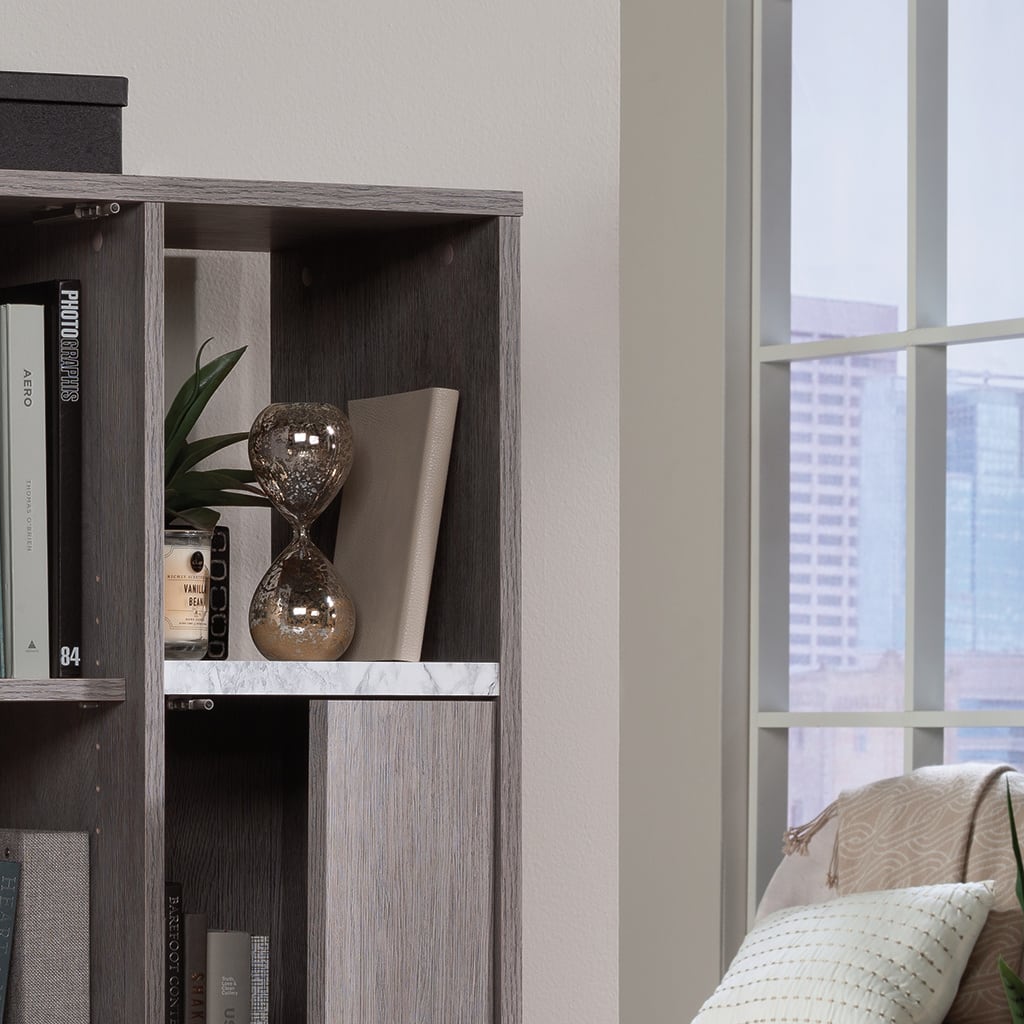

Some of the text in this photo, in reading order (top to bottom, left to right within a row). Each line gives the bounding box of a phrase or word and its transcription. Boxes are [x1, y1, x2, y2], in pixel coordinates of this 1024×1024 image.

[61, 290, 79, 402] PHOTOGRAPHIS
[23, 368, 32, 408] AERO
[60, 646, 81, 666] 84
[169, 896, 180, 973] BAREFOOT
